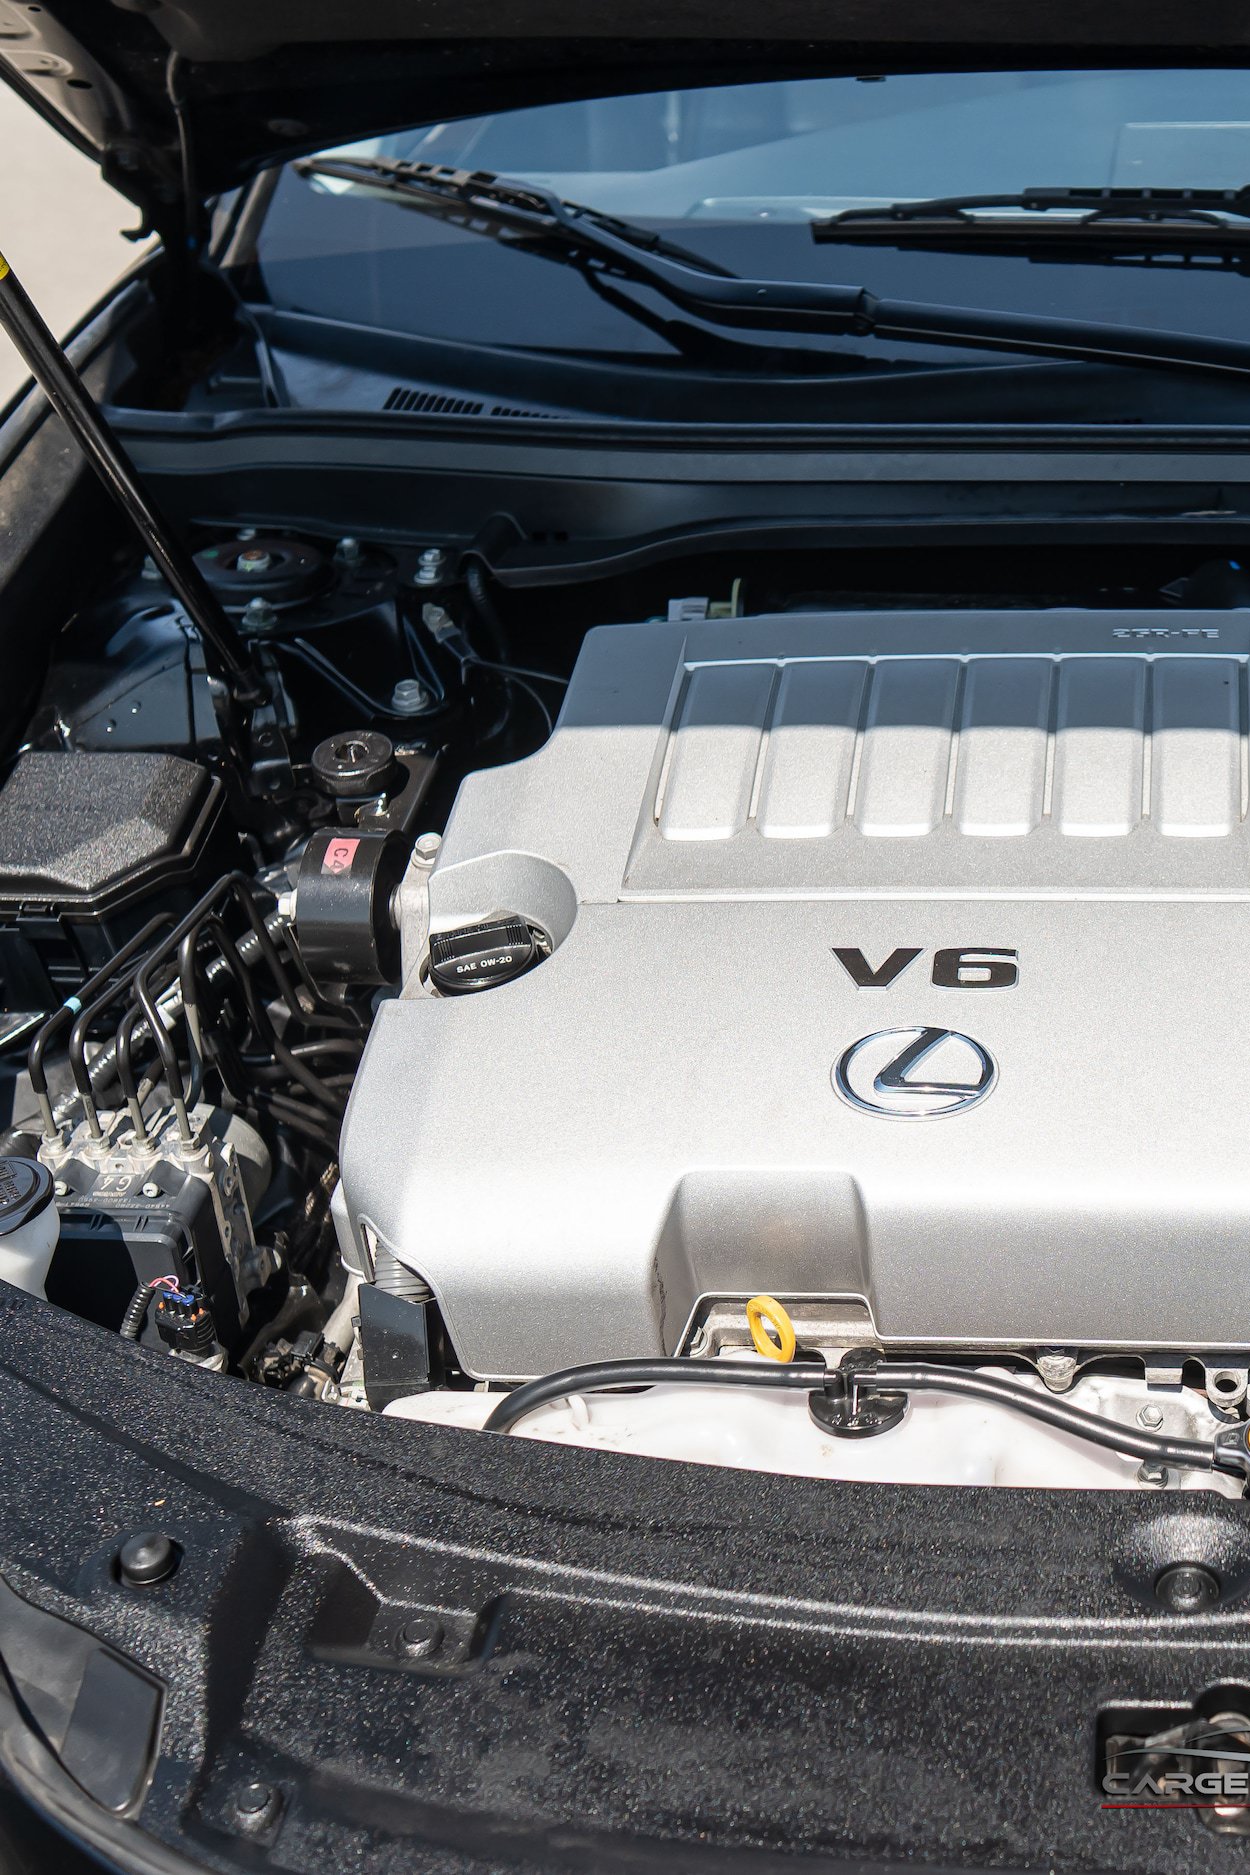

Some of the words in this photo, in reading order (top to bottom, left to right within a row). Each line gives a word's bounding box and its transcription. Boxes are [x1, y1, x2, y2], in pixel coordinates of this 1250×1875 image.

[456, 962, 477, 974] SAE
[480, 955, 513, 968] 0W-20
[830, 947, 1019, 992] V6
